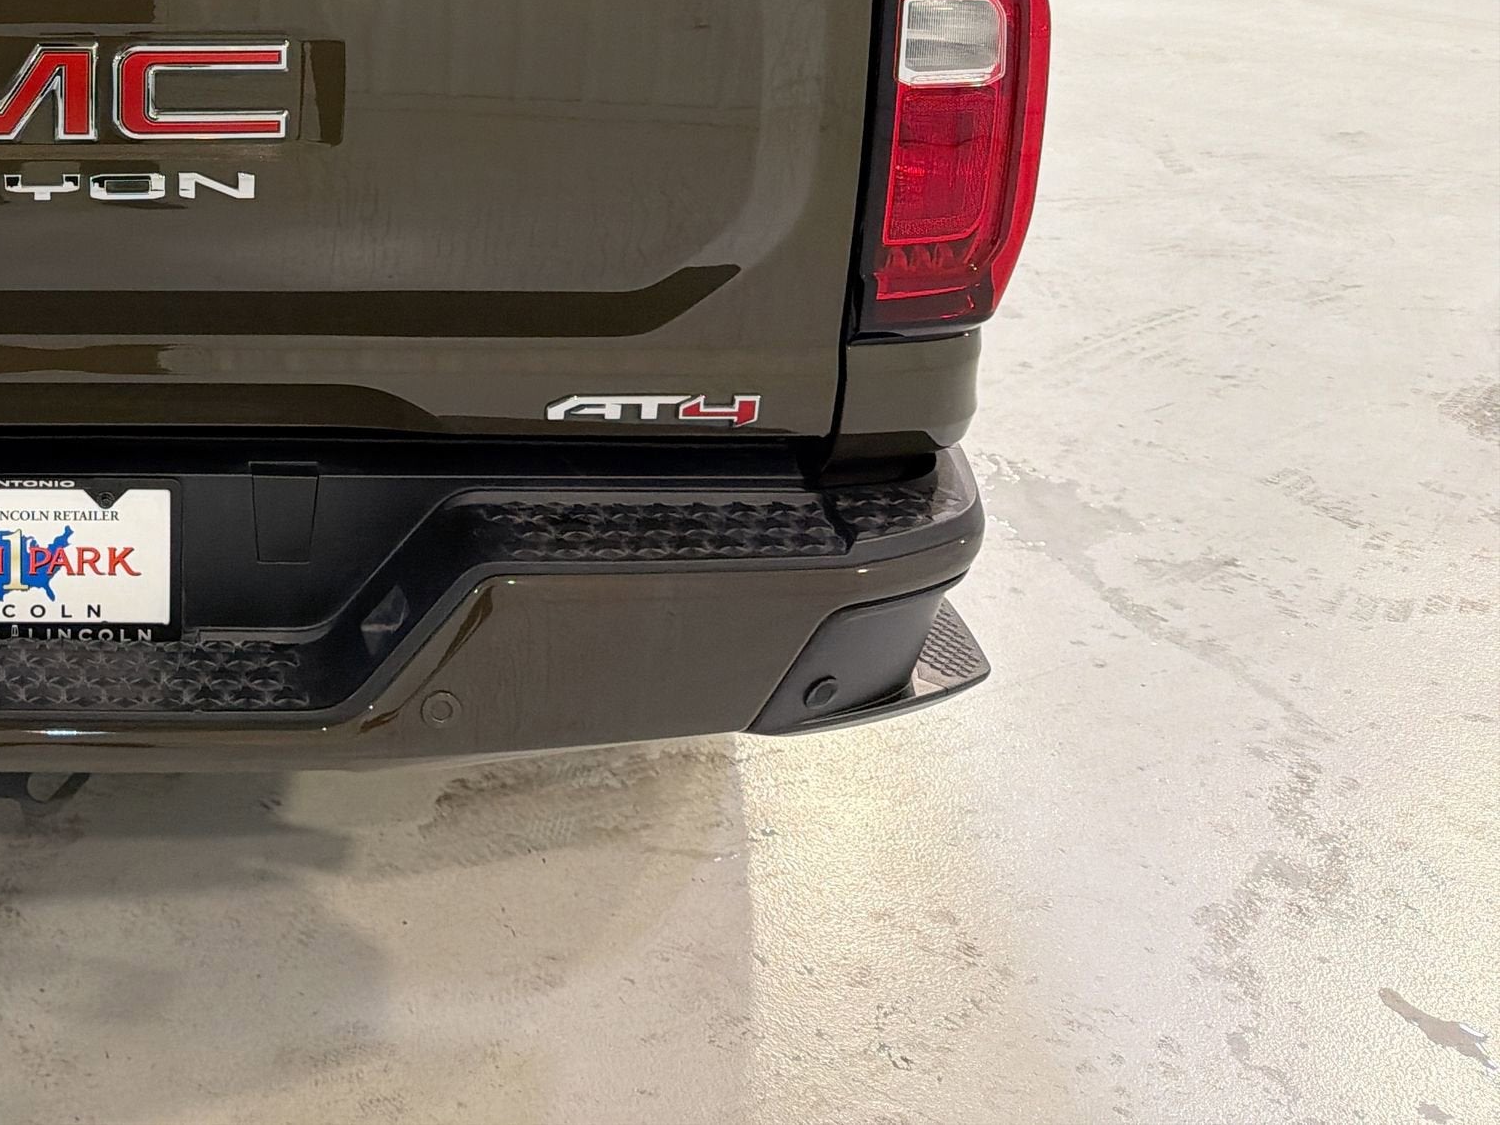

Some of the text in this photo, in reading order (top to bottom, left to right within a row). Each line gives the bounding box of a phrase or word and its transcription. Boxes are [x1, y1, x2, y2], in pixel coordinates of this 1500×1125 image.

[546, 394, 761, 427] AT4
[53, 510, 120, 522] RETAILER
[28, 547, 142, 576] PARK
